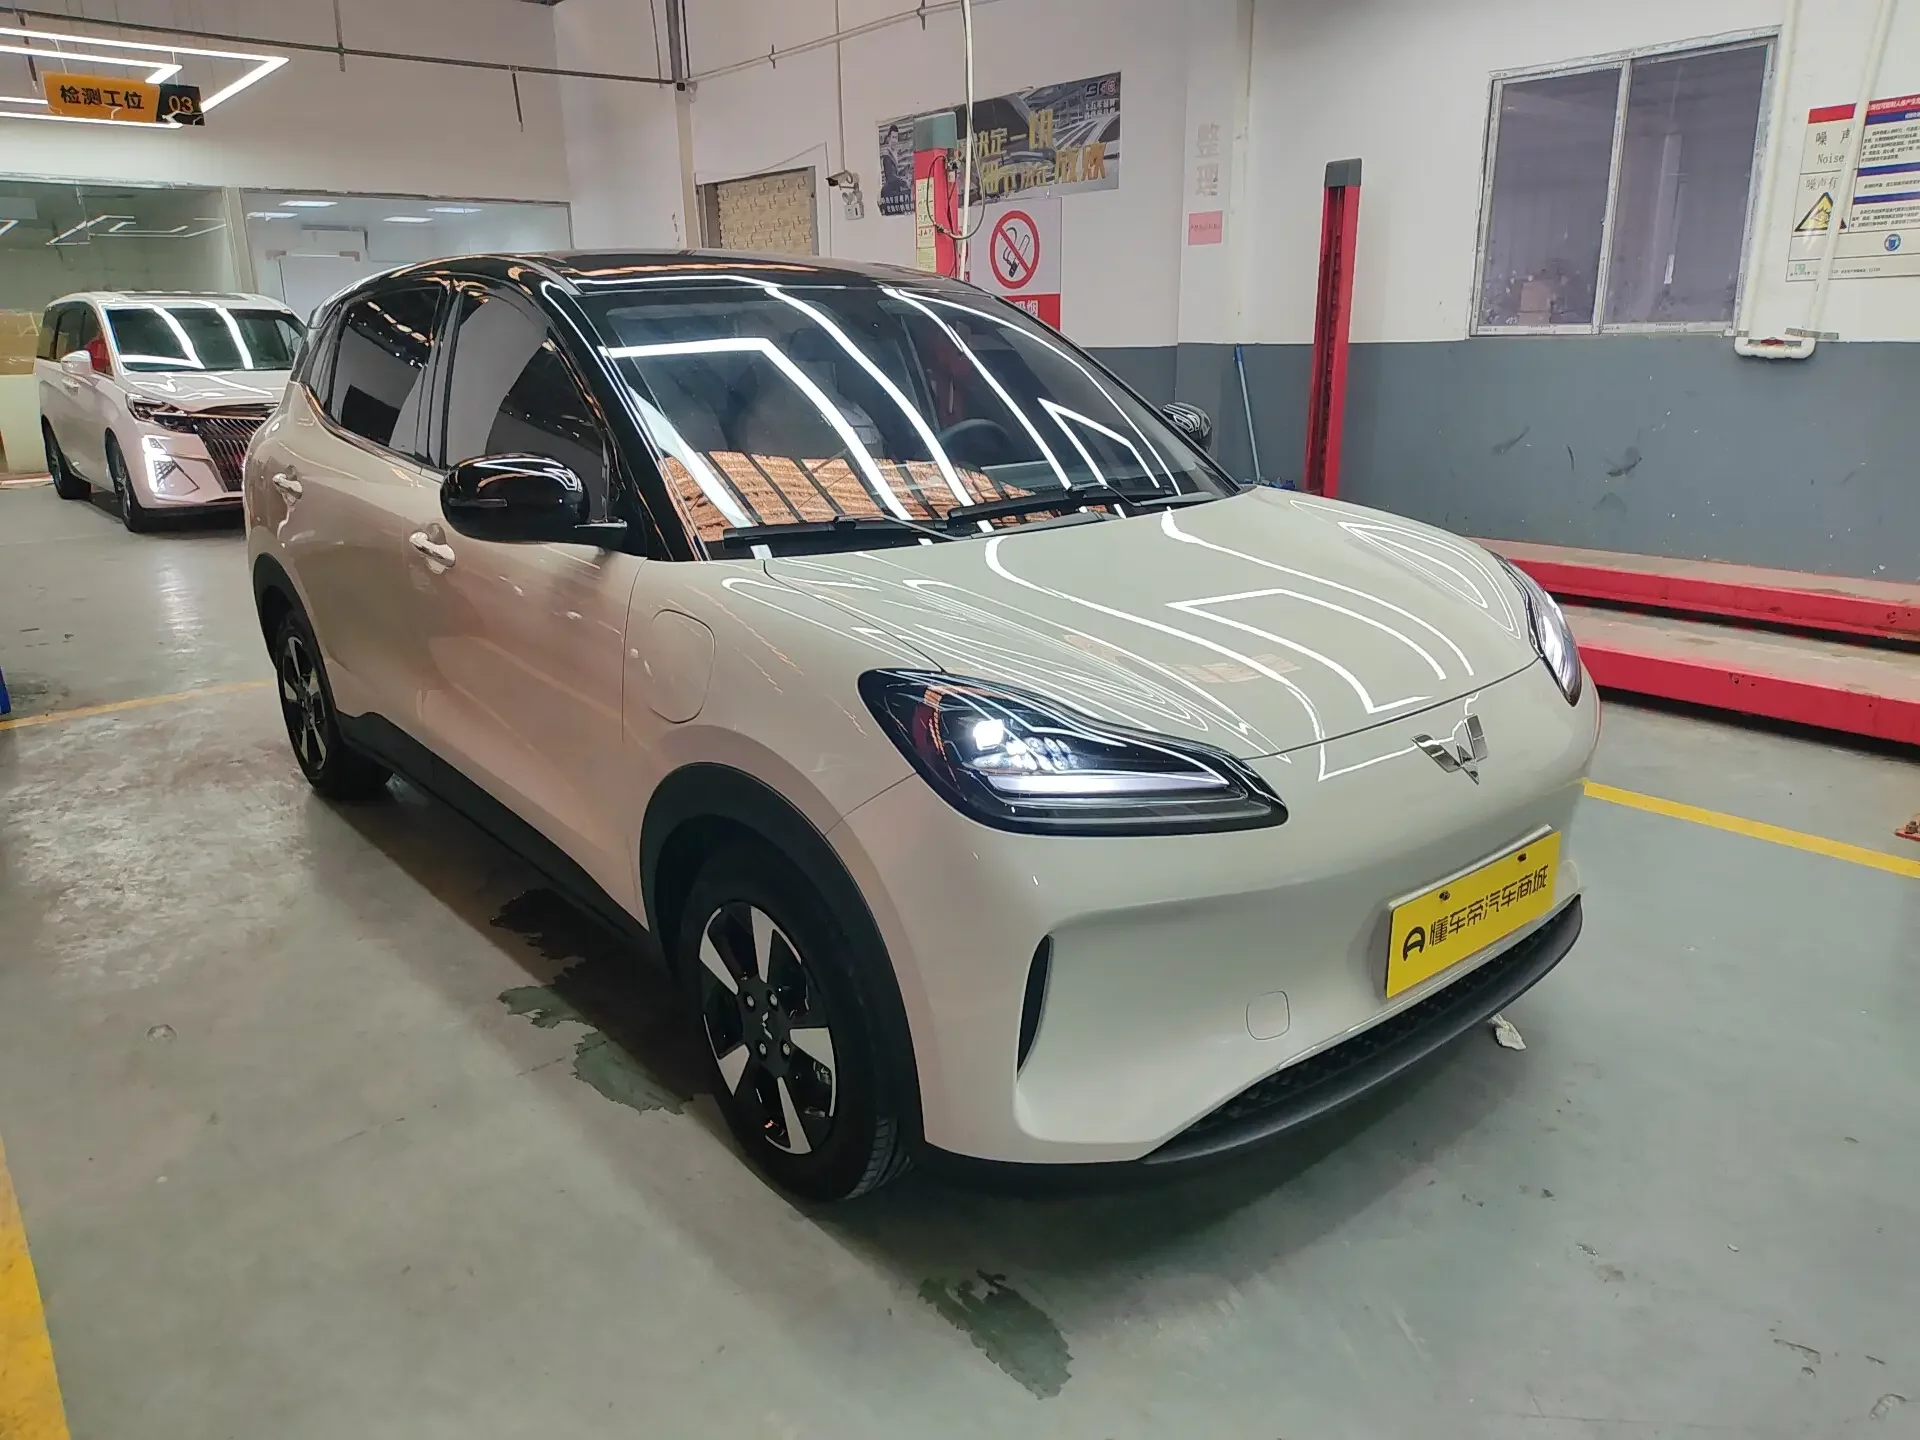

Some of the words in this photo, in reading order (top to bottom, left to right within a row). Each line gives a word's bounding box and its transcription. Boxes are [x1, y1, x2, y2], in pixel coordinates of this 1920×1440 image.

[60, 84, 145, 110] 检测工位
[168, 95, 194, 114] 03
[1816, 152, 1845, 165] Noise
[1429, 864, 1549, 947] 懂车帝汽车商城
